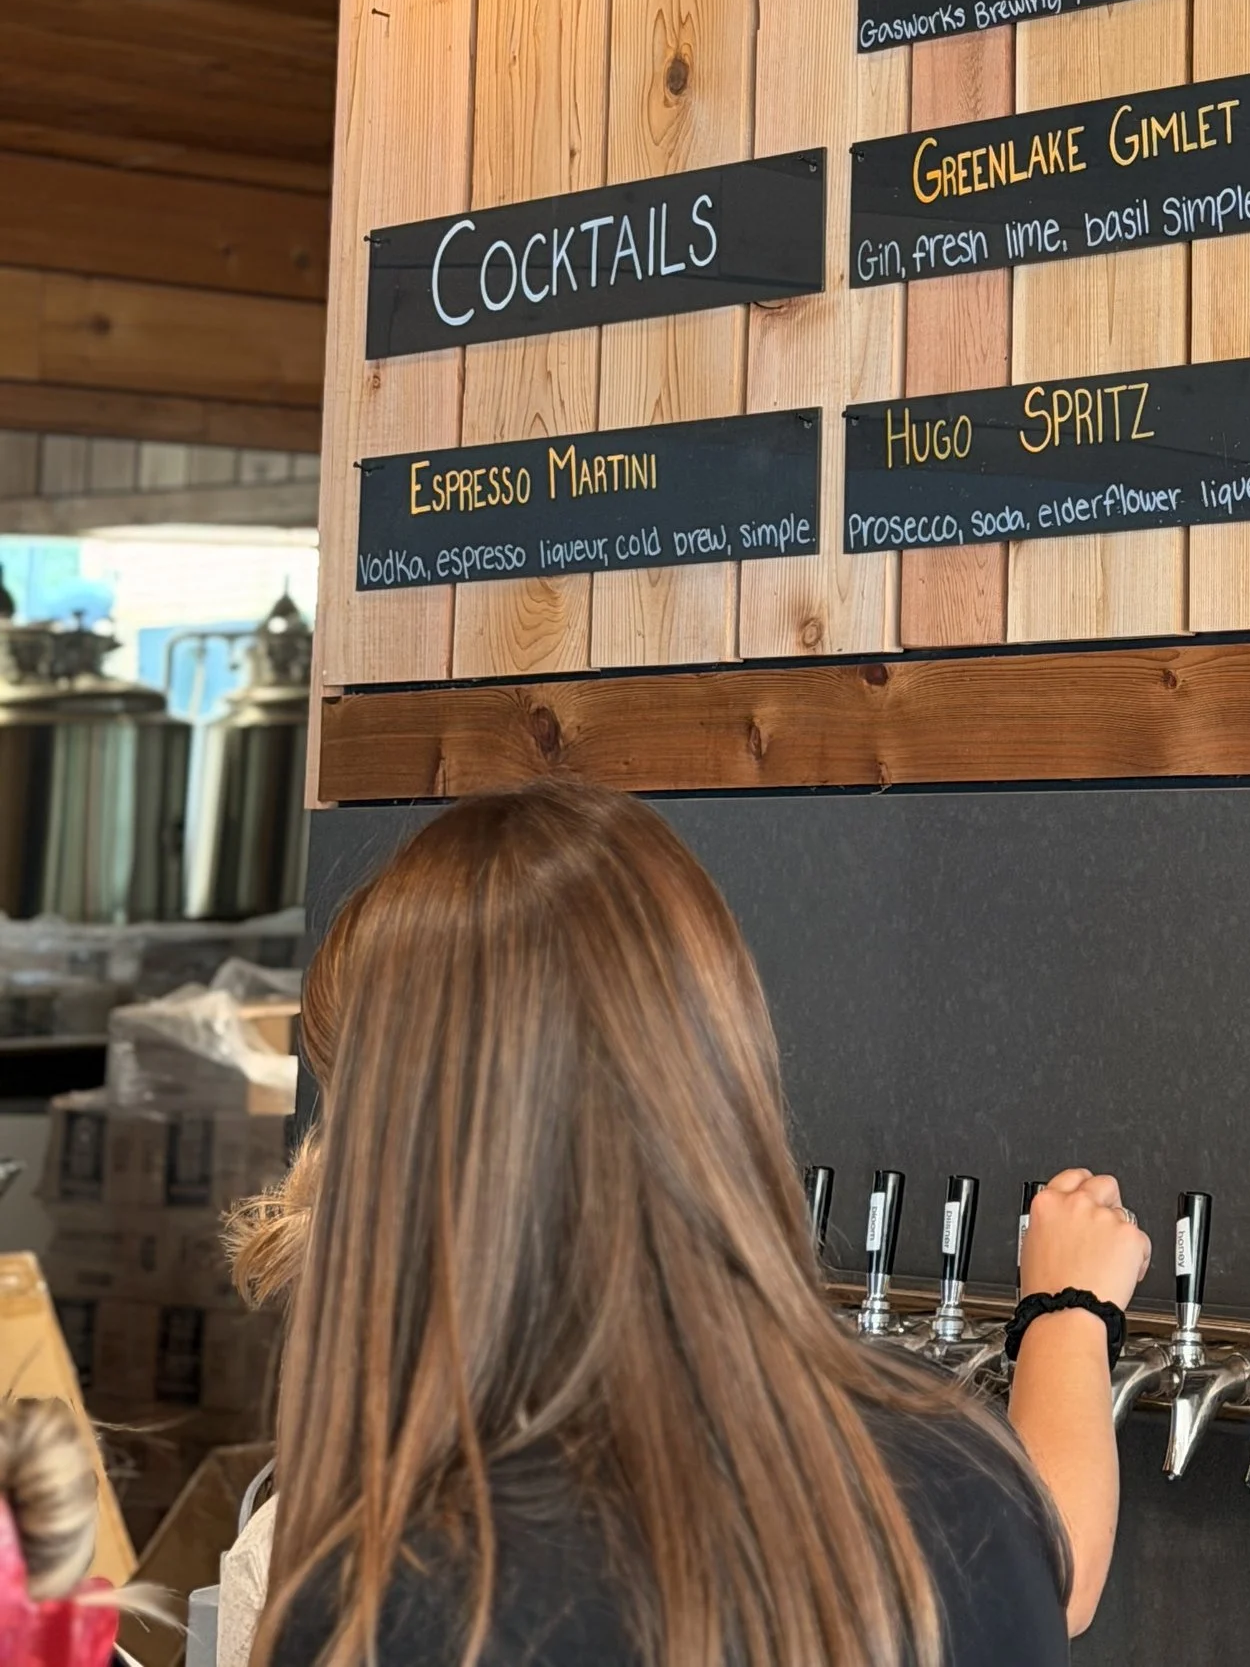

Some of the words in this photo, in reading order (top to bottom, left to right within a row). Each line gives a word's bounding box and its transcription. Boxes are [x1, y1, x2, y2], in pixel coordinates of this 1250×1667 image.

[860, 4, 966, 48] Gasworks
[912, 125, 1086, 204] GREENLAKE
[1109, 99, 1240, 166] GIMLET
[432, 194, 718, 326] COCKTAILS
[857, 238, 906, 281] Gin,
[912, 227, 987, 273] fresh
[1084, 199, 1149, 247] basil
[887, 407, 972, 469] HUGO
[1020, 381, 1154, 453] SPRITZ
[410, 460, 531, 514] ESPRESSO
[548, 444, 657, 500] MARTINI
[1038, 484, 1181, 526] elderflower
[436, 543, 526, 579] espresso
[616, 526, 661, 560] cold
[673, 525, 731, 556] brew,
[1177, 1230, 1185, 1268] honey
